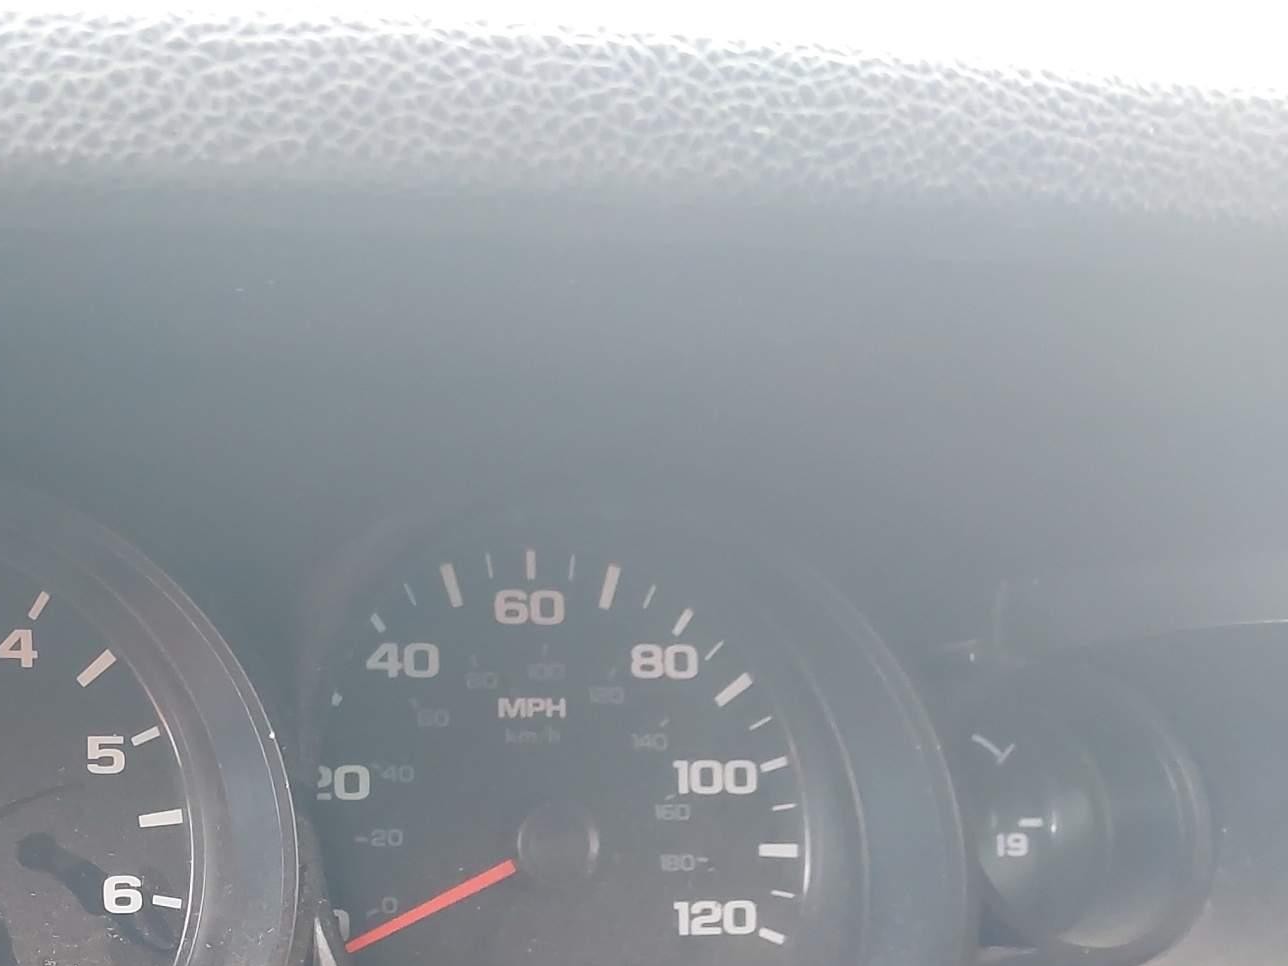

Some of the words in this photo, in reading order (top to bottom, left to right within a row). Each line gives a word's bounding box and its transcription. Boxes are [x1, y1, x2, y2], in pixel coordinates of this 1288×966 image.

[494, 589, 566, 626] 60
[366, 643, 440, 679] 40
[630, 644, 699, 680] 80
[498, 698, 567, 718] MPH
[86, 735, 126, 775] 5
[380, 764, 416, 783] 40
[673, 759, 758, 795] 100
[653, 803, 692, 821] 160
[369, 828, 404, 848] 20
[996, 833, 1029, 857] 19
[102, 875, 143, 915] 6
[673, 900, 758, 936] 120
